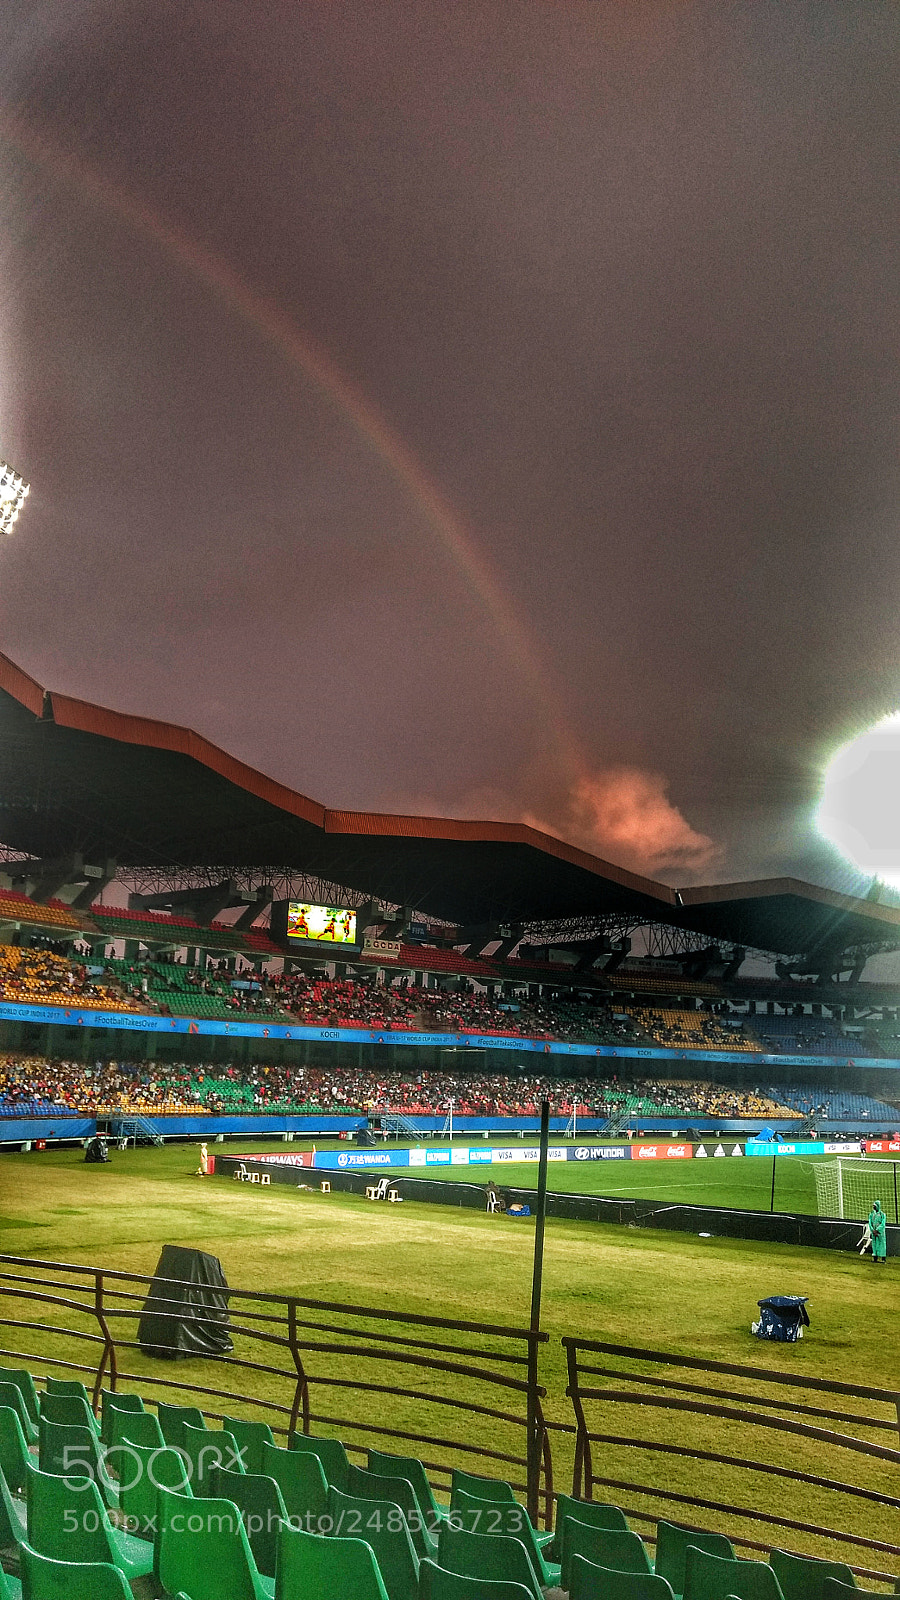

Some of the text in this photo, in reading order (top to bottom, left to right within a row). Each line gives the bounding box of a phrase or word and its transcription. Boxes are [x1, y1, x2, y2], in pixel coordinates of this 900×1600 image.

[411, 927, 425, 935] FIFA
[373, 941, 400, 951] GCDA
[94, 1015, 158, 1028] #FootballTakesOver
[320, 1031, 340, 1039] KOCHI
[498, 1151, 513, 1159] VISA
[524, 1151, 538, 1159] VISA
[548, 1150, 562, 1158] VISA
[590, 1148, 625, 1159] HYUNDAI
[364, 1154, 391, 1164] WANDA
